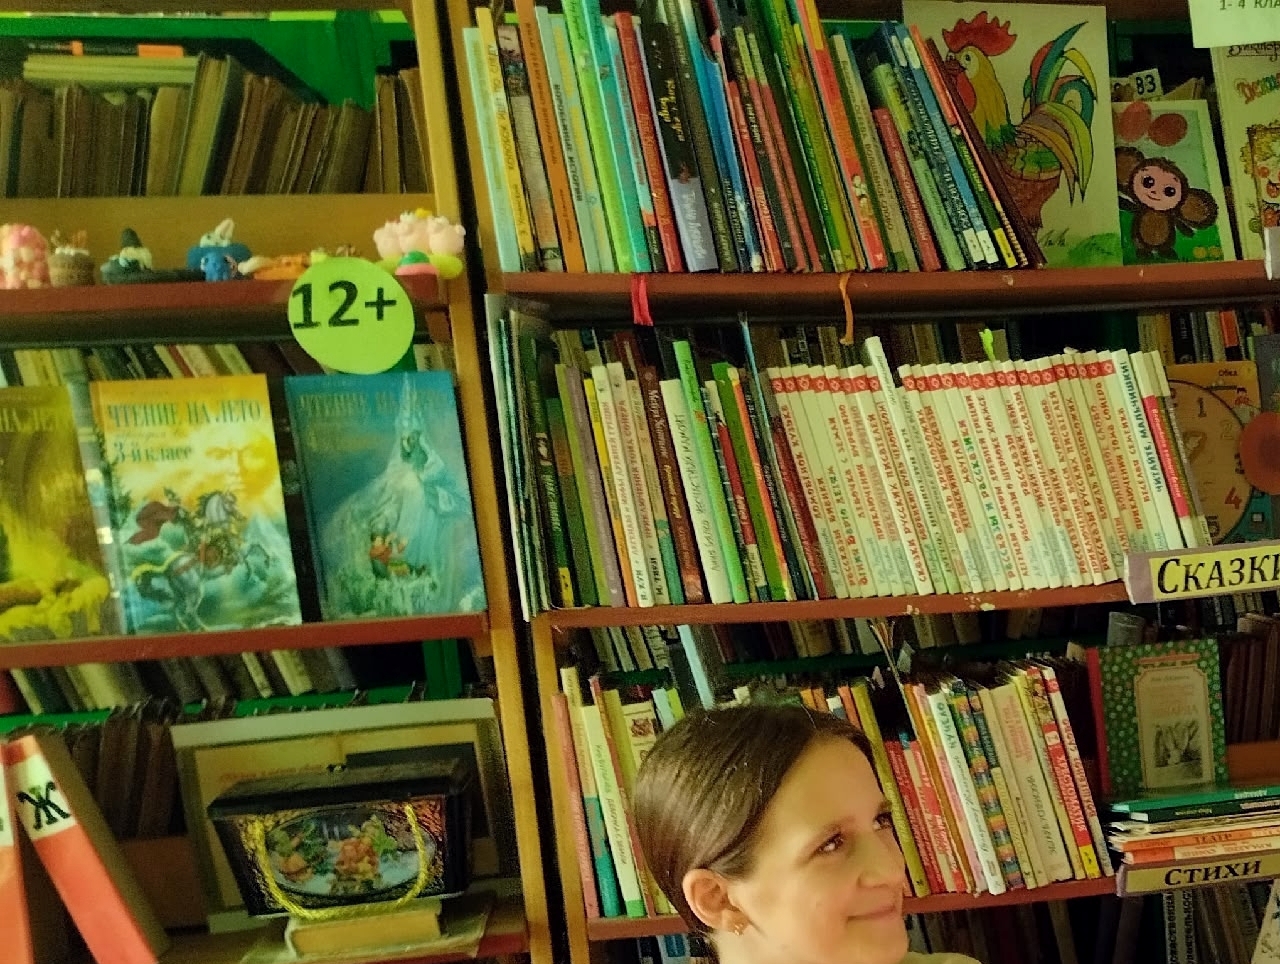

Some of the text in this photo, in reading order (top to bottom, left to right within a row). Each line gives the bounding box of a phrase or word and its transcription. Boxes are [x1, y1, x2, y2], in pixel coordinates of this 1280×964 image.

[1135, 73, 1156, 93] 83
[291, 281, 398, 329] 12+
[1119, 360, 1149, 438] МАЛЬЧИШКИ!
[17, 781, 70, 830] Ж
